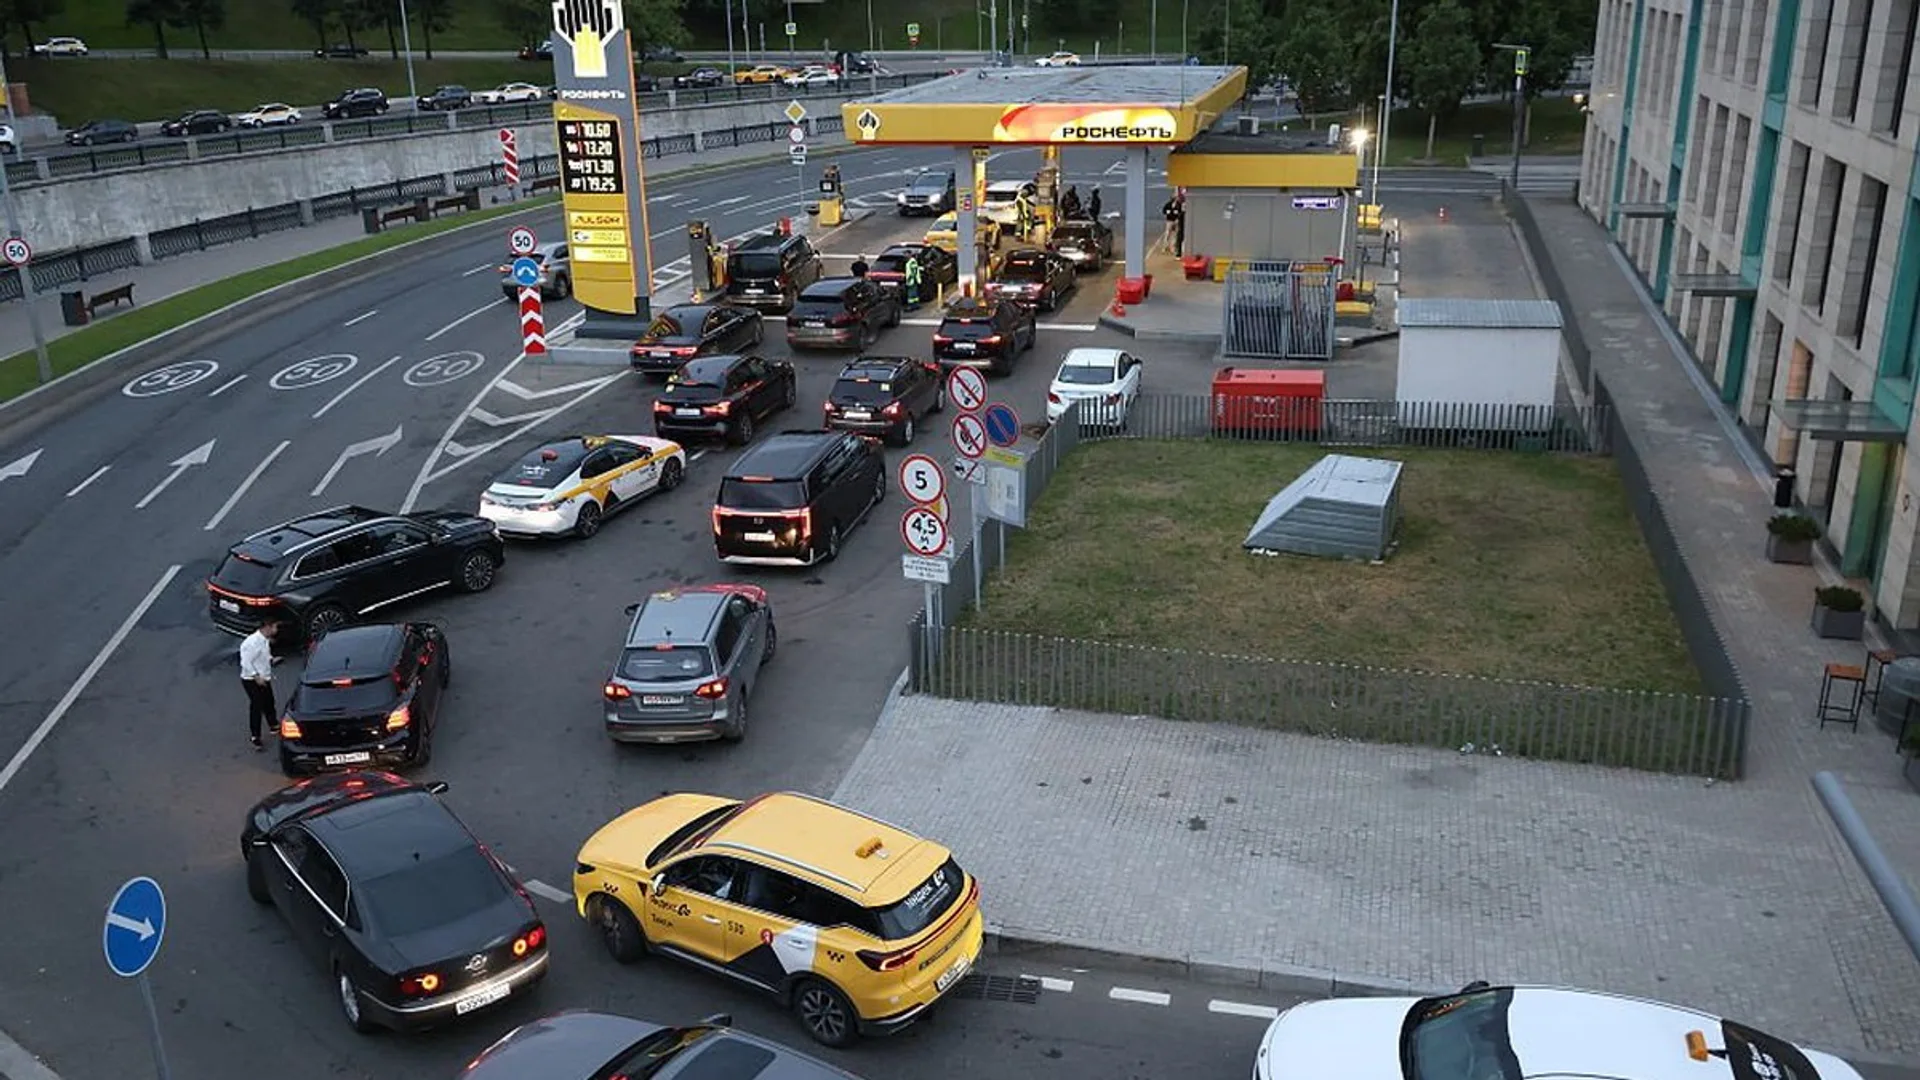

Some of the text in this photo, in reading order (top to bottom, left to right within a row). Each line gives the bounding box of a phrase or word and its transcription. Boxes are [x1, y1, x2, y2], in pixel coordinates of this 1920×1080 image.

[562, 89, 626, 99] РОСНЕФТЬ
[1062, 127, 1171, 139] РОСНЕФТЬ
[514, 236, 531, 247] 50
[9, 245, 25, 257] 50
[284, 362, 345, 379] 50
[416, 359, 471, 377] 50
[140, 367, 204, 387] 50
[915, 470, 928, 490] 5
